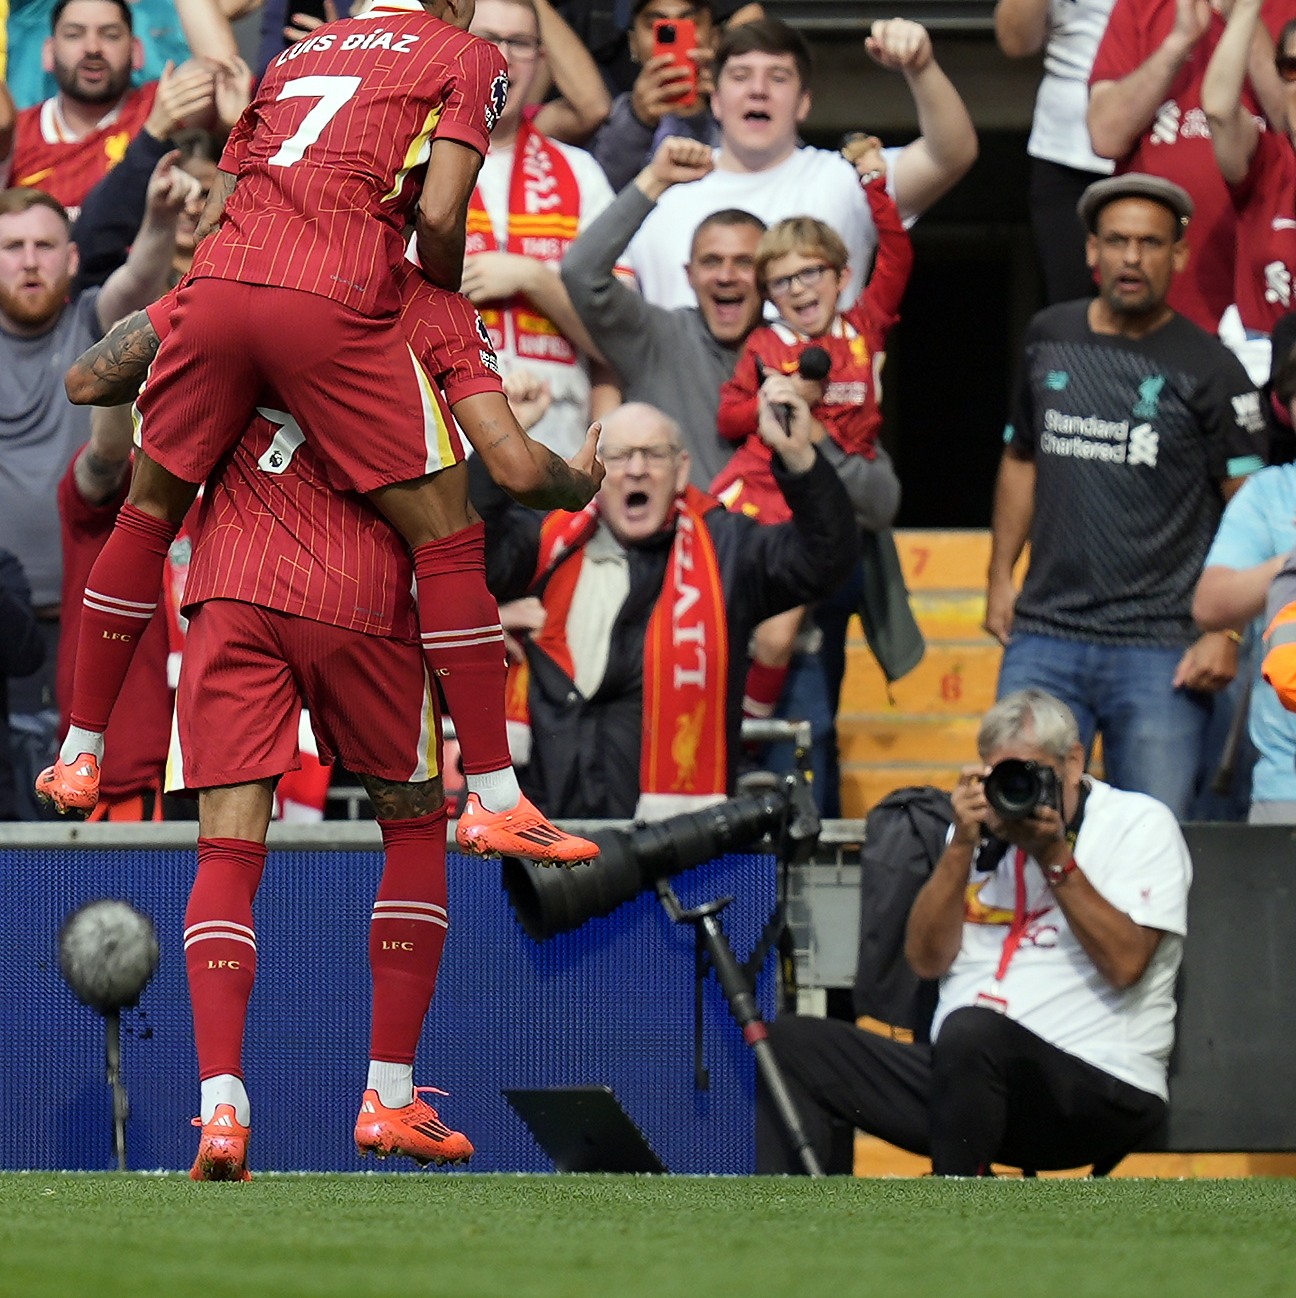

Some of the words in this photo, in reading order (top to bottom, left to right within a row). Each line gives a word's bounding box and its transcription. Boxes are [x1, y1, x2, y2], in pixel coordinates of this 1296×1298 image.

[275, 34, 337, 67] LUIS
[267, 74, 364, 168] 7
[1044, 408, 1129, 442] Standard
[1040, 431, 1128, 464] Chartered
[102, 630, 132, 643] LFC
[381, 940, 414, 951] LFC
[207, 959, 240, 970] LFC
